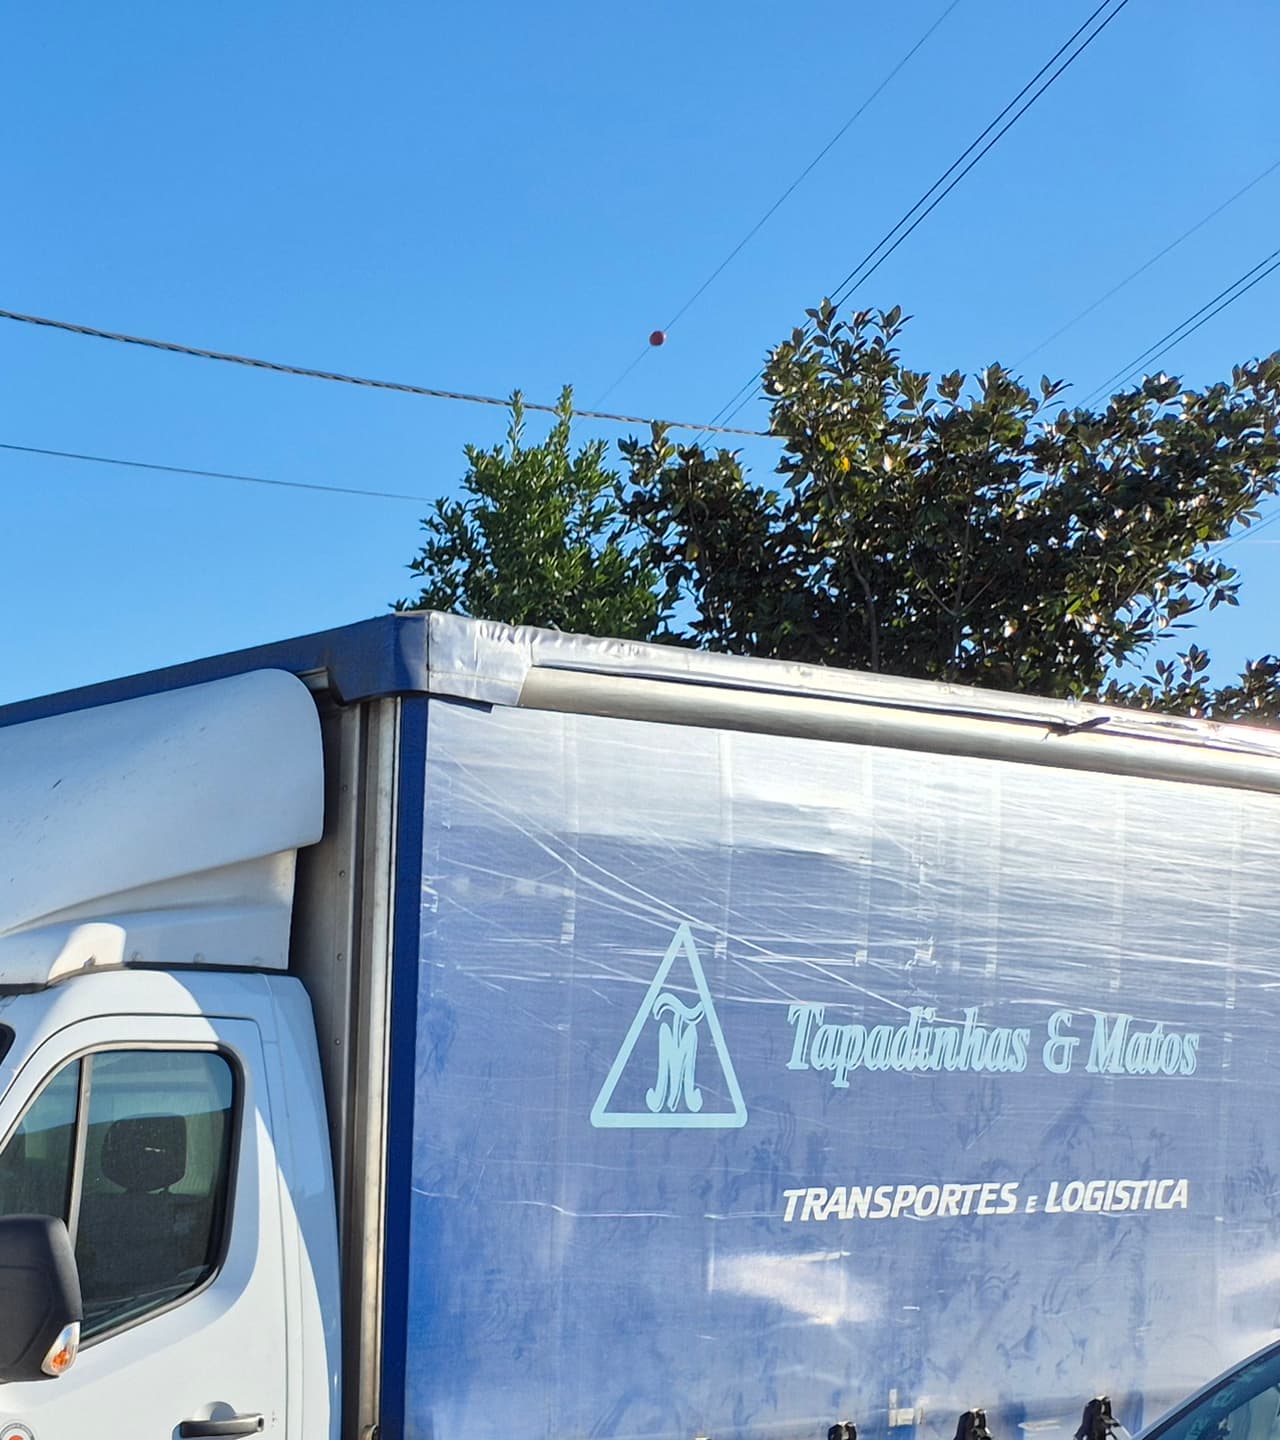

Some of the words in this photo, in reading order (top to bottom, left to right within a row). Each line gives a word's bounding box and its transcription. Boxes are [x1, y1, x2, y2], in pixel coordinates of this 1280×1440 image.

[786, 1003, 1030, 1087] Tapadinhas
[1043, 1010, 1080, 1074] &
[1085, 1013, 1200, 1076] Matos
[783, 1182, 1019, 1222] TRANSPORTES
[1045, 1179, 1189, 1213] LOGISTICA
